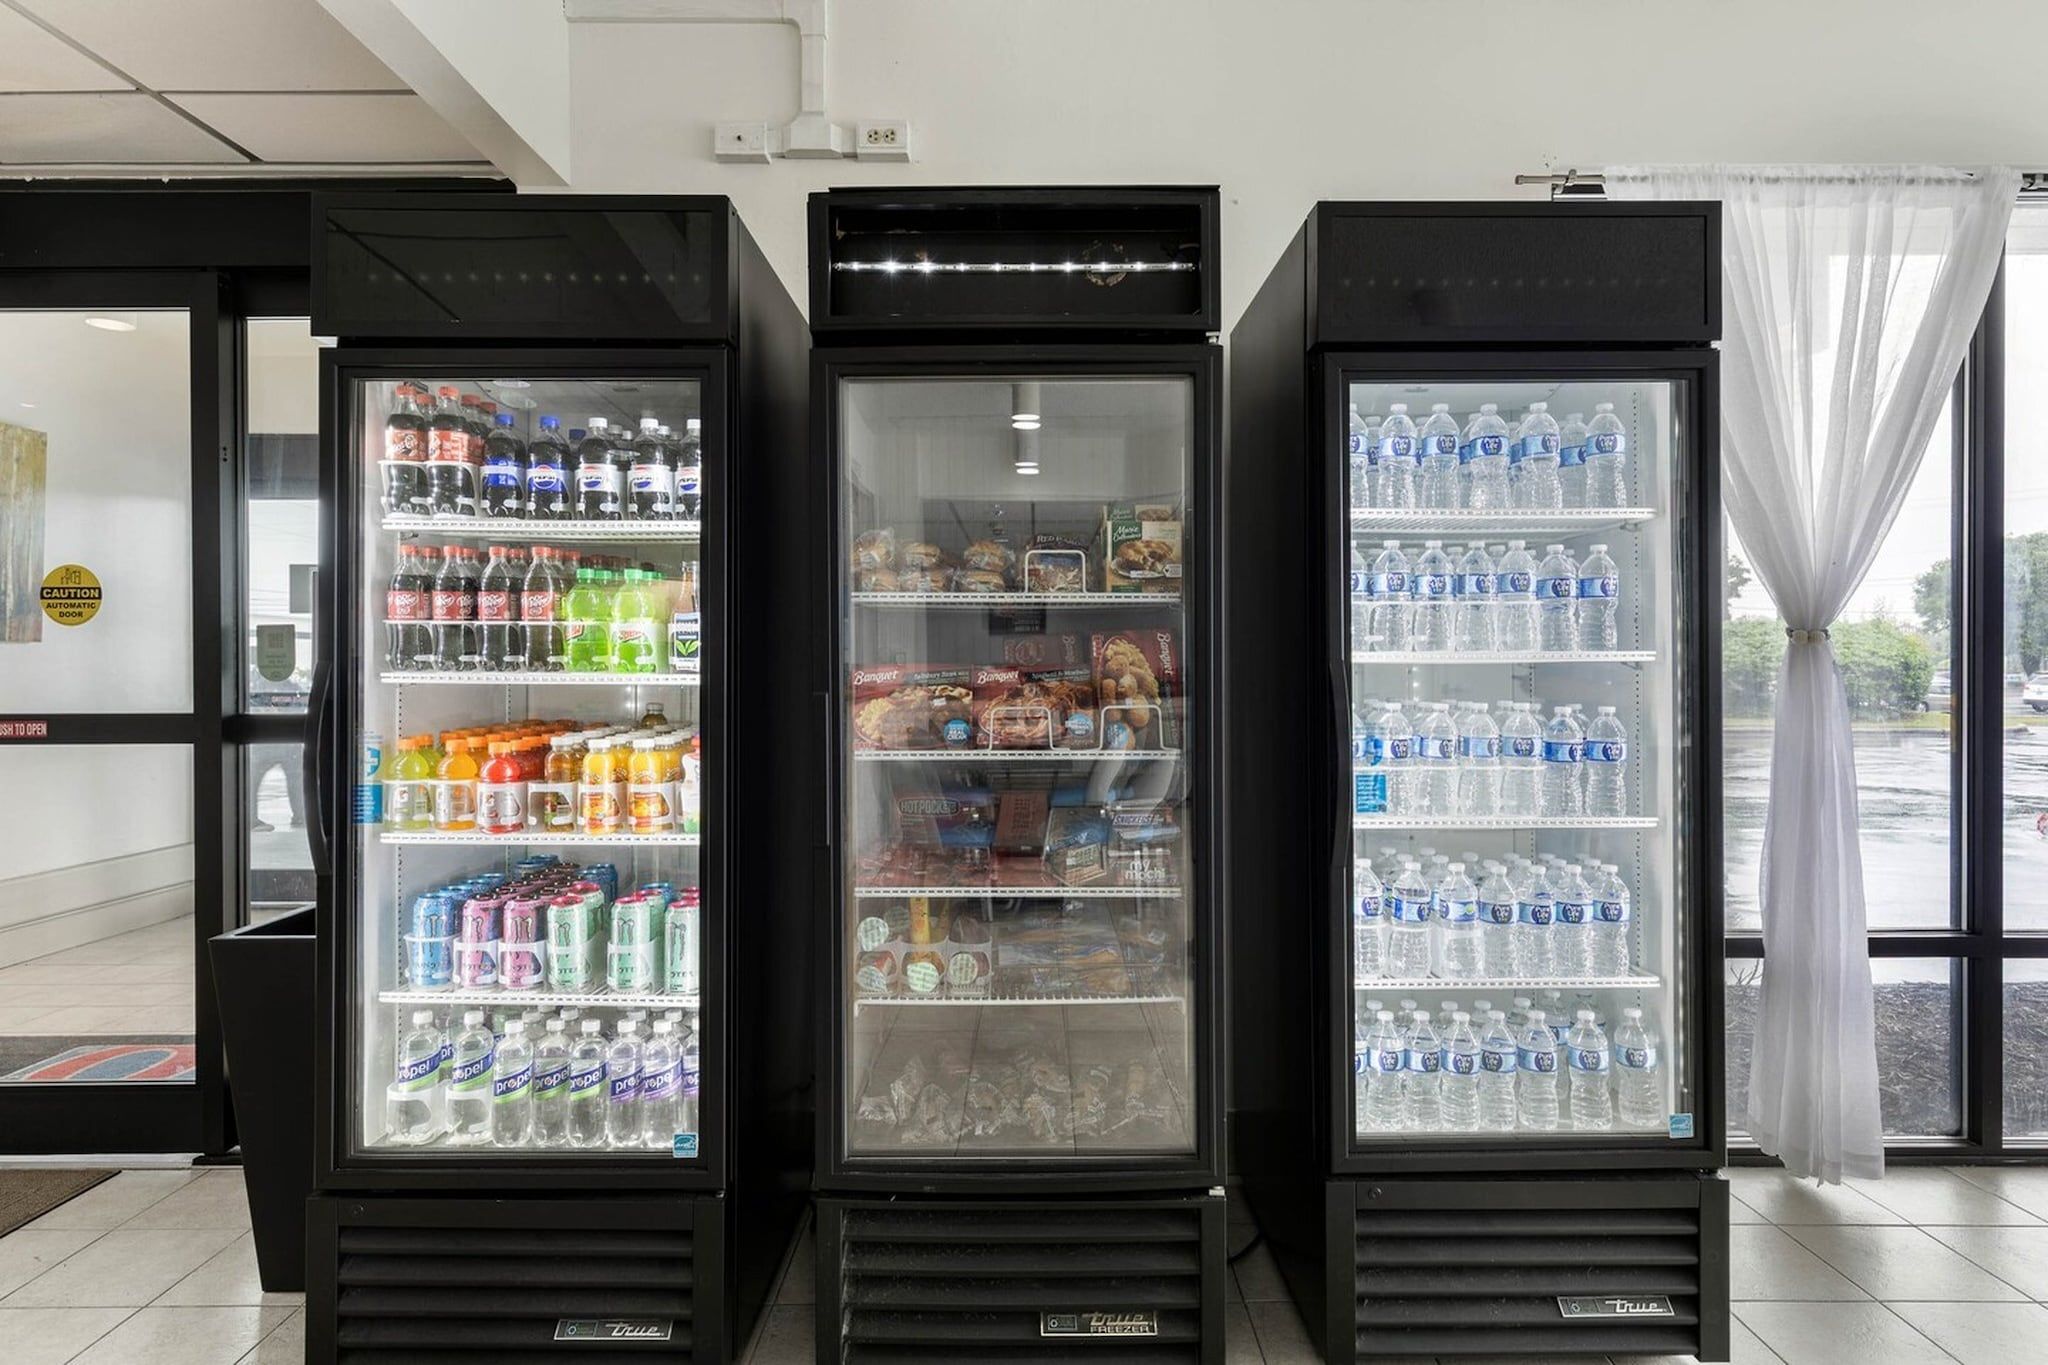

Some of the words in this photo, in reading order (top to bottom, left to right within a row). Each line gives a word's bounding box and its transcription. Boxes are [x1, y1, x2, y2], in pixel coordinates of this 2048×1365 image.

[43, 588, 100, 599] CAUTION
[46, 602, 96, 610] AUTOMATIC
[1157, 633, 1174, 676] Banquet
[853, 670, 899, 685] Banquet
[977, 670, 1019, 684] Banquet
[15, 724, 25, 735] TO
[27, 723, 47, 735] OPEN
[1130, 860, 1151, 873] my
[1125, 868, 1166, 880] mochi
